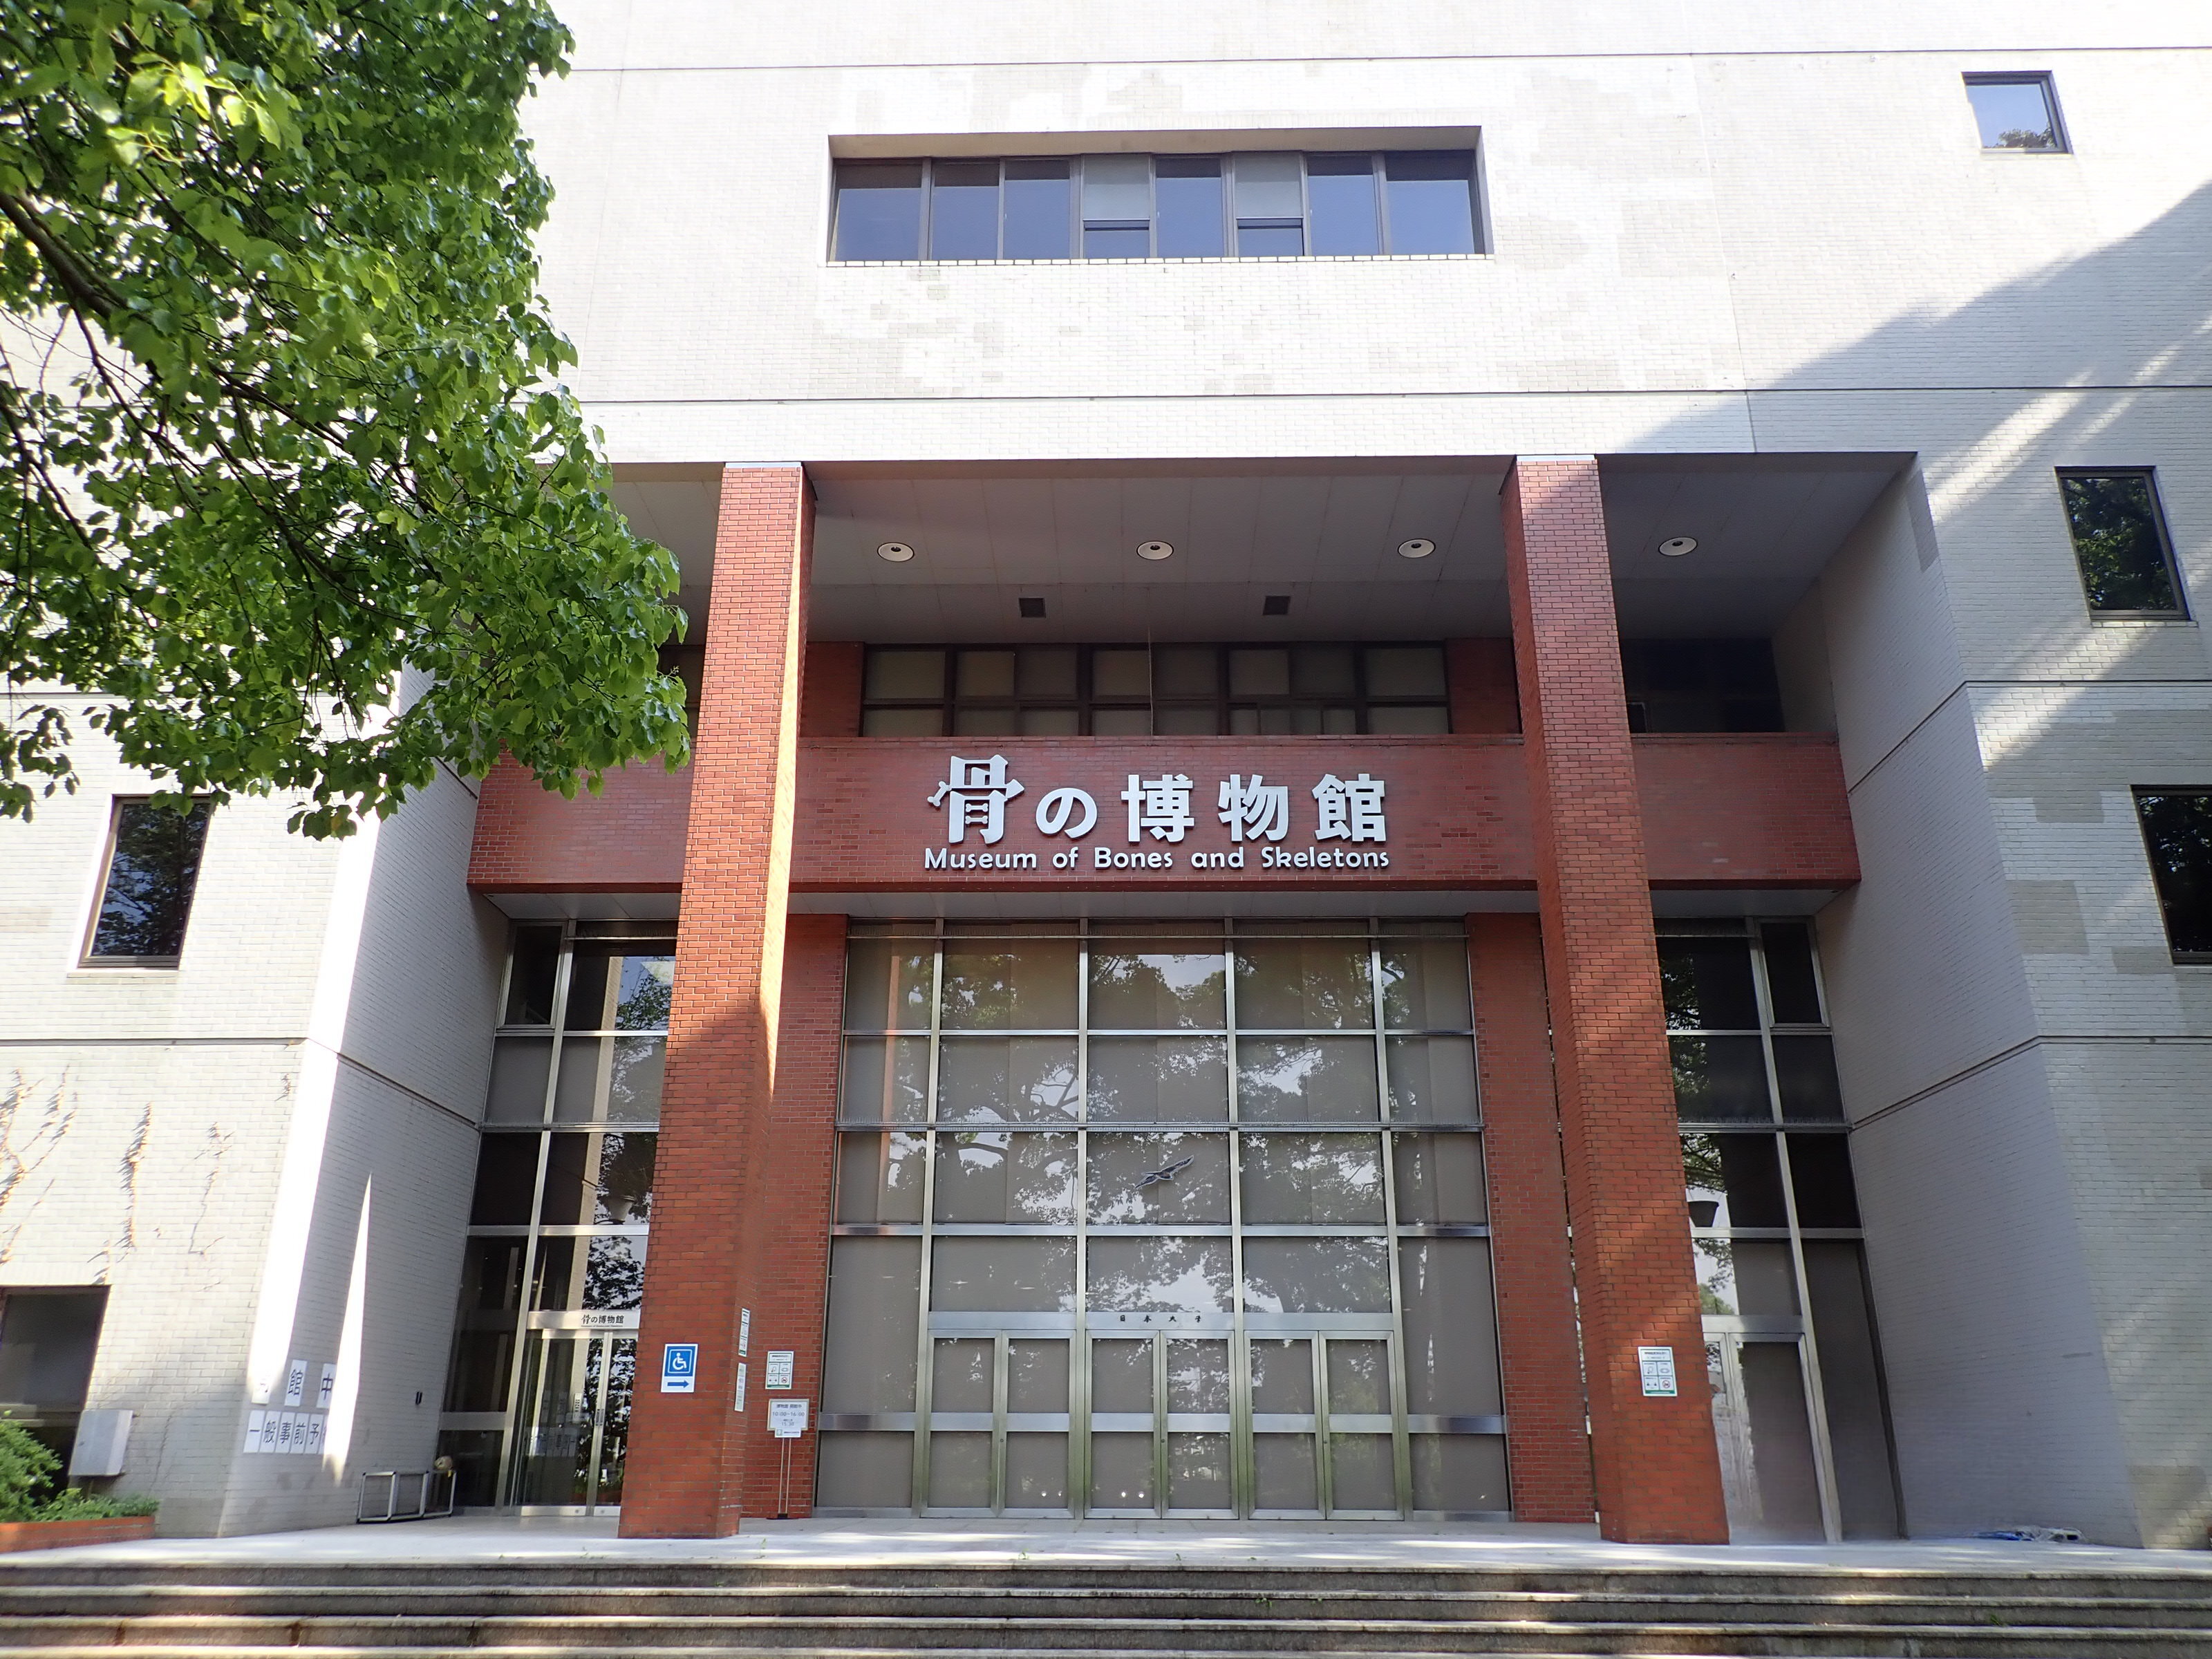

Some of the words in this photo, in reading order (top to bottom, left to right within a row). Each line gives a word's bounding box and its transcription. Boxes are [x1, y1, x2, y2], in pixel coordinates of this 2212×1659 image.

[927, 754, 1387, 845] 骨の博物館
[924, 847, 1037, 870] Museum
[1052, 846, 1079, 870] of
[1094, 846, 1174, 870] Bones
[1191, 846, 1245, 869] and
[1261, 846, 1389, 870] Skeletons
